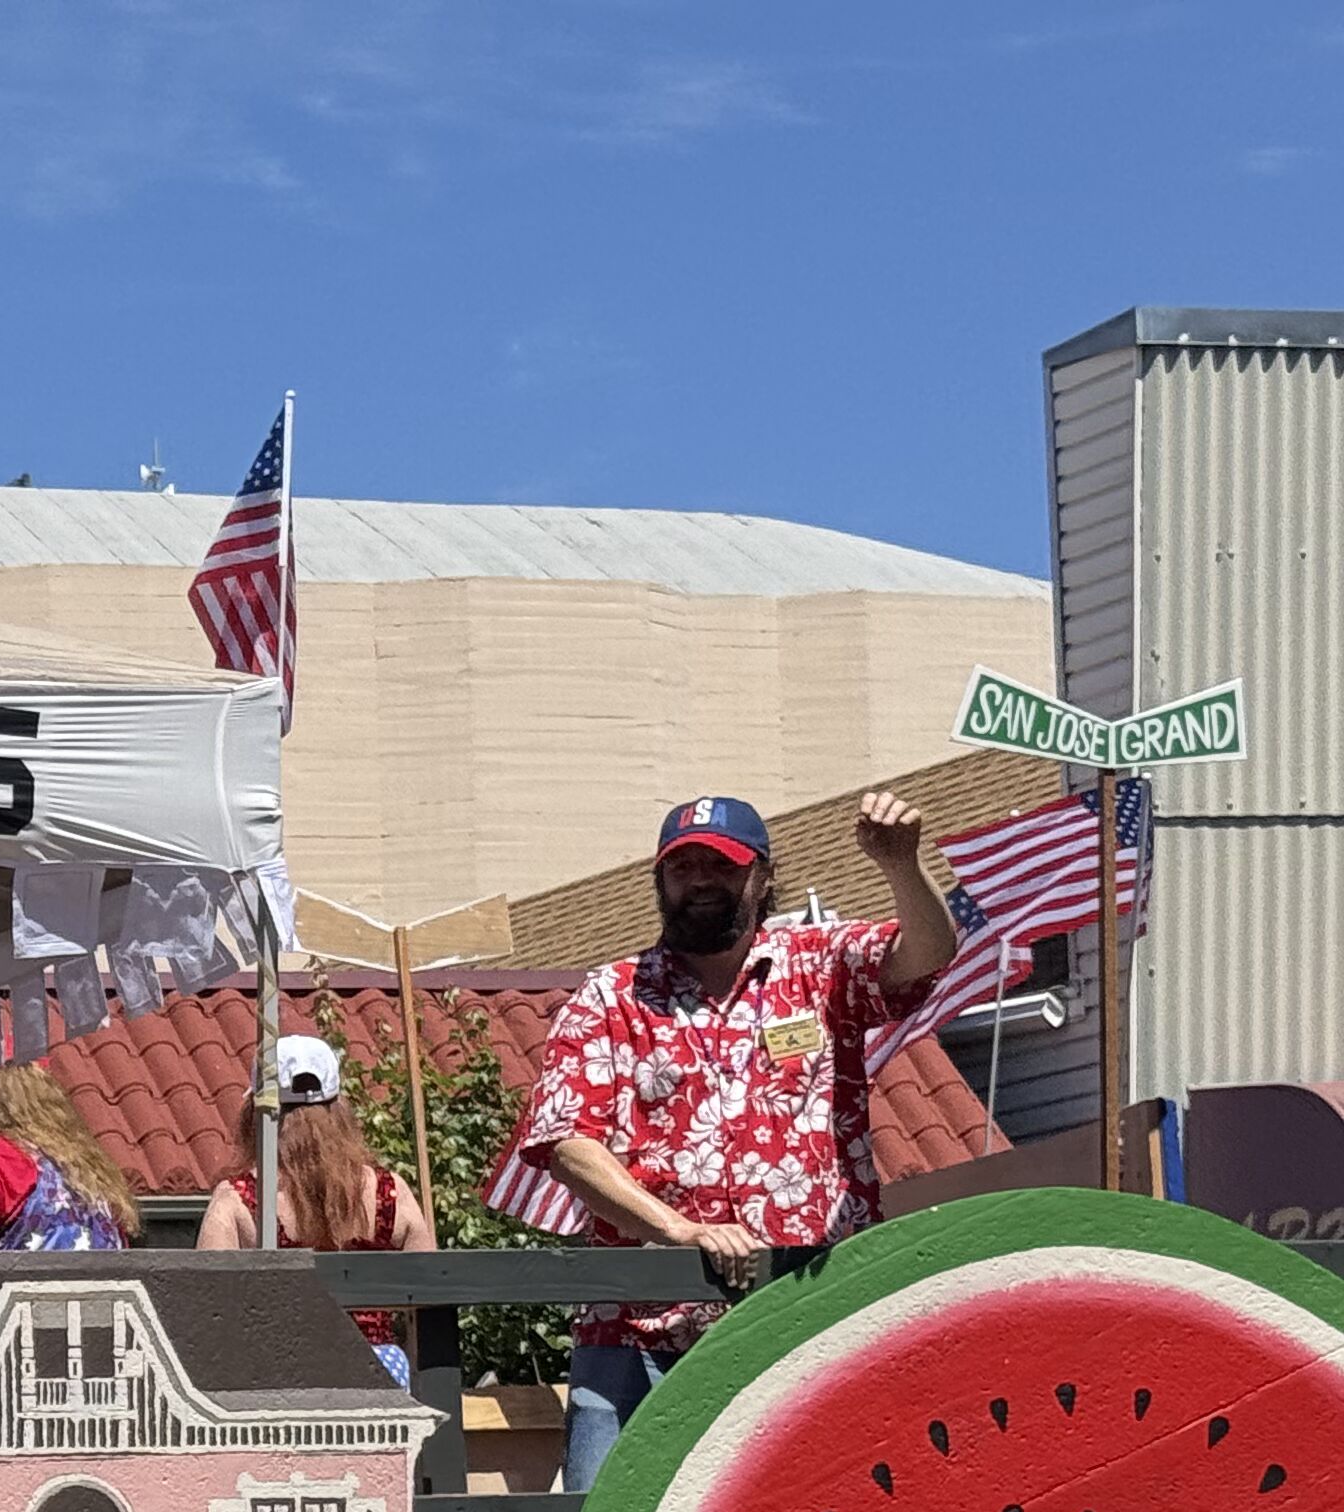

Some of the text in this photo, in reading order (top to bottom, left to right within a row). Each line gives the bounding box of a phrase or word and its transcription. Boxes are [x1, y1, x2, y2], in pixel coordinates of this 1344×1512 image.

[969, 682, 1108, 763] SAN JOSE
[1119, 702, 1235, 761] GRAND
[677, 799, 728, 830] USA
